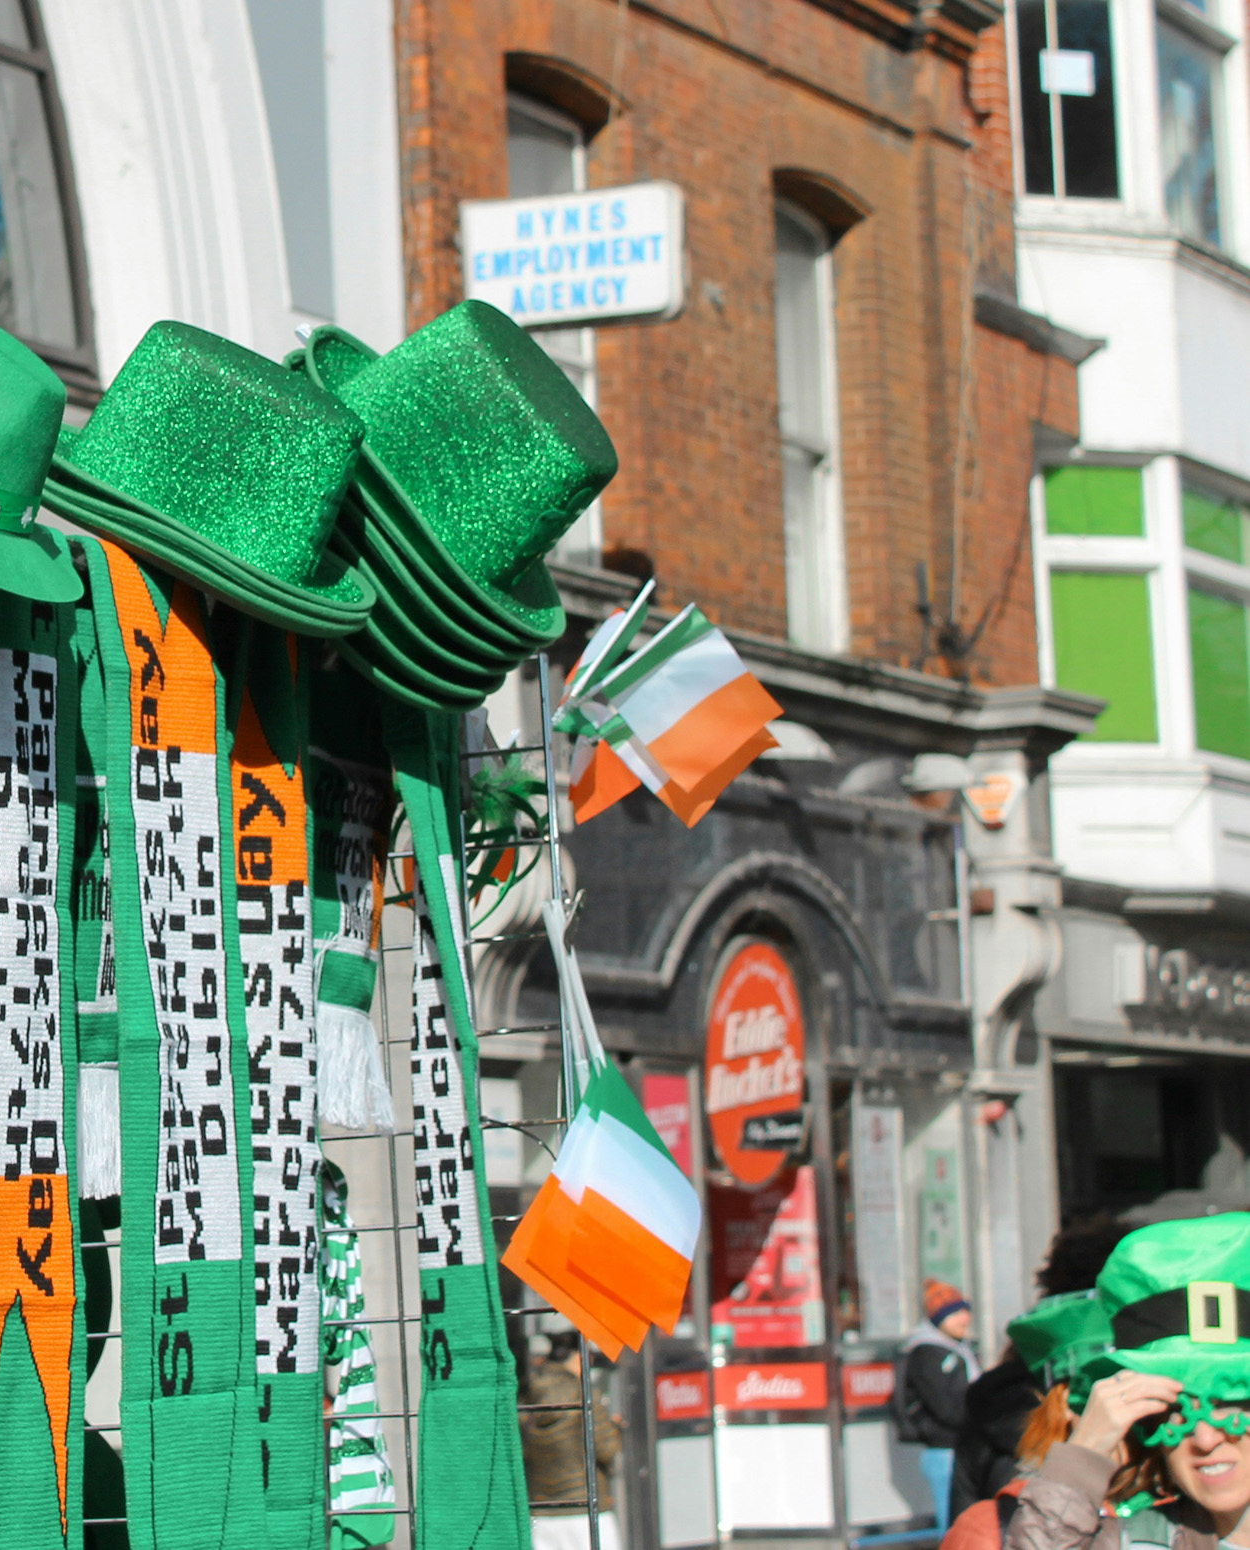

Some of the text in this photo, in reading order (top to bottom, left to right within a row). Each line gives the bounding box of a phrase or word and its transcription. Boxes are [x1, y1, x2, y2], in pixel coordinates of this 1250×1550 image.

[473, 234, 664, 281] EMPLOYMENT
[512, 275, 627, 315] AGENCY
[517, 201, 627, 238] HYNES
[134, 629, 164, 801] Day
[5, 651, 31, 1180] March 17th
[30, 671, 55, 1088] Patrick's
[163, 746, 205, 1260] March 17th
[192, 836, 227, 1155] Dublin
[17, 1121, 57, 1296] Day
[278, 880, 304, 1373] March 17th
[427, 1004, 462, 1265] March
[158, 1272, 193, 1396] St
